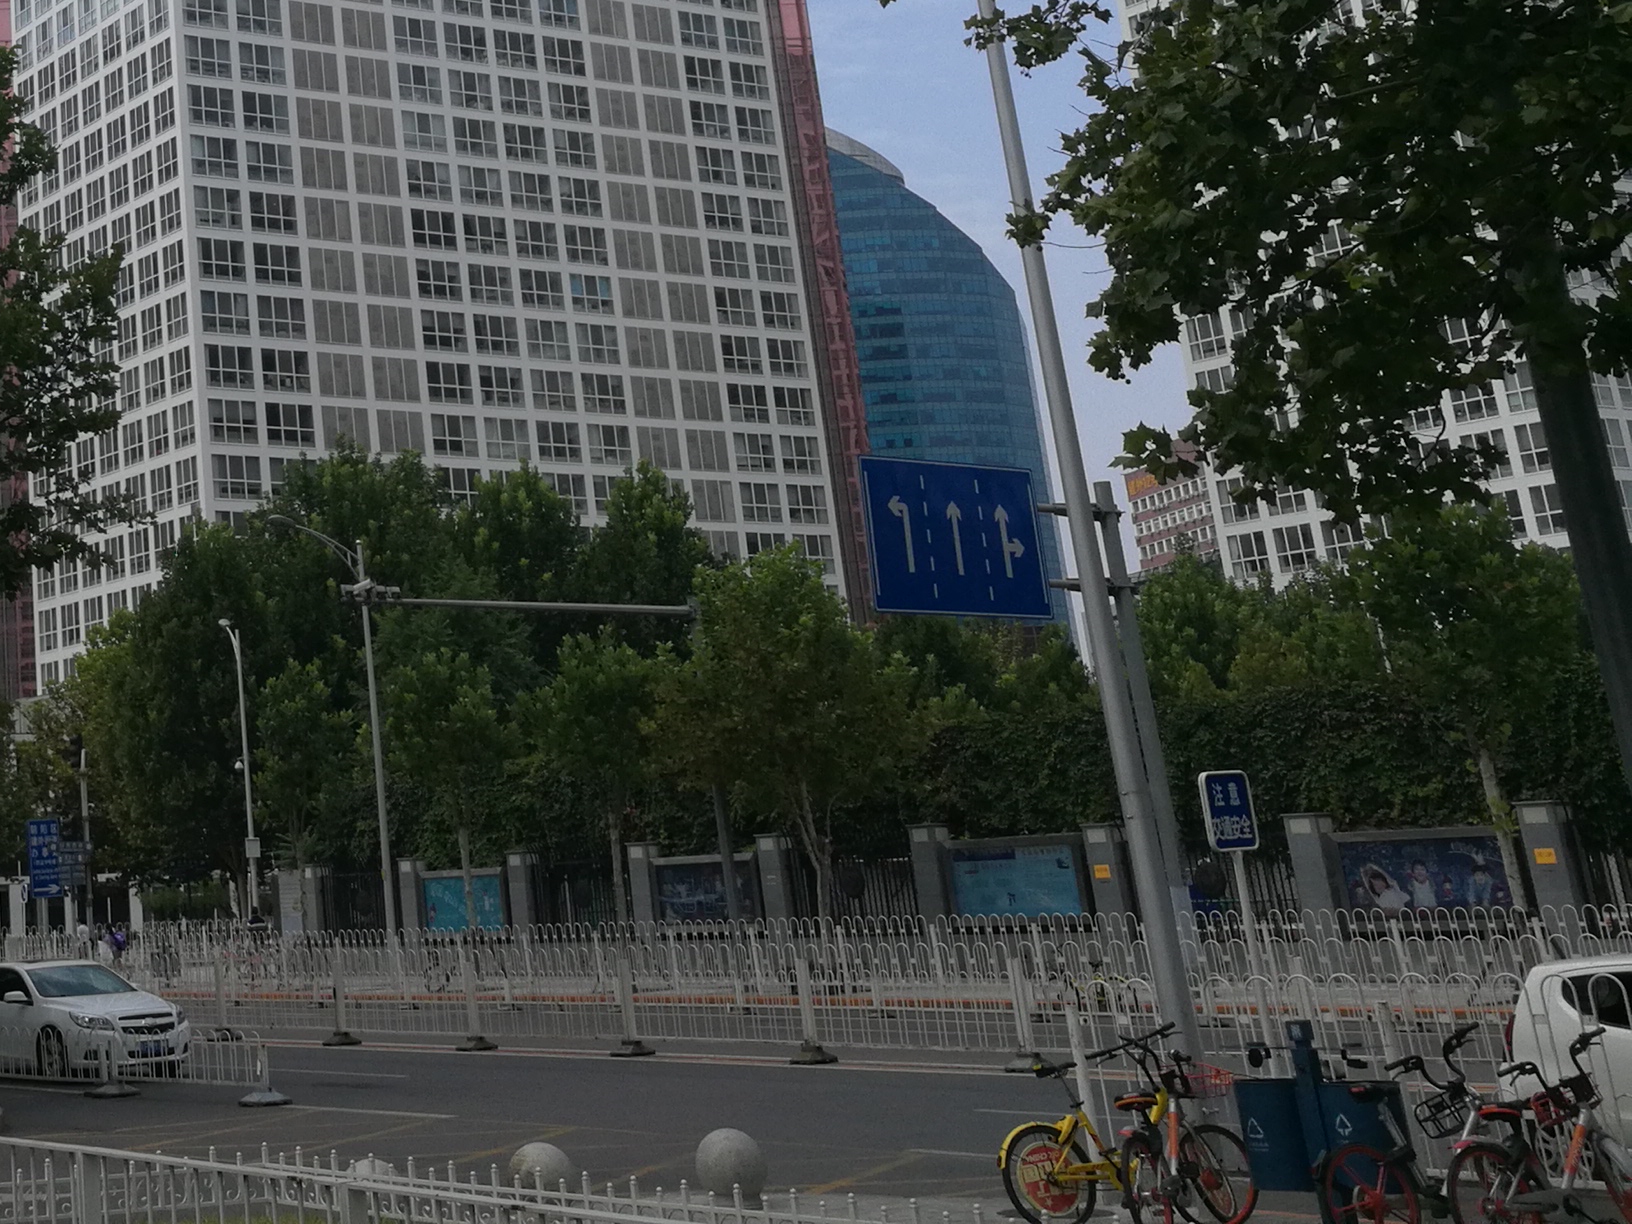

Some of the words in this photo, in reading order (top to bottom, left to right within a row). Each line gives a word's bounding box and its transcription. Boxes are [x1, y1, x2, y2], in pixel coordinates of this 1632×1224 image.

[1211, 781, 1241, 807] 注意
[1211, 813, 1253, 840] 交通安全
